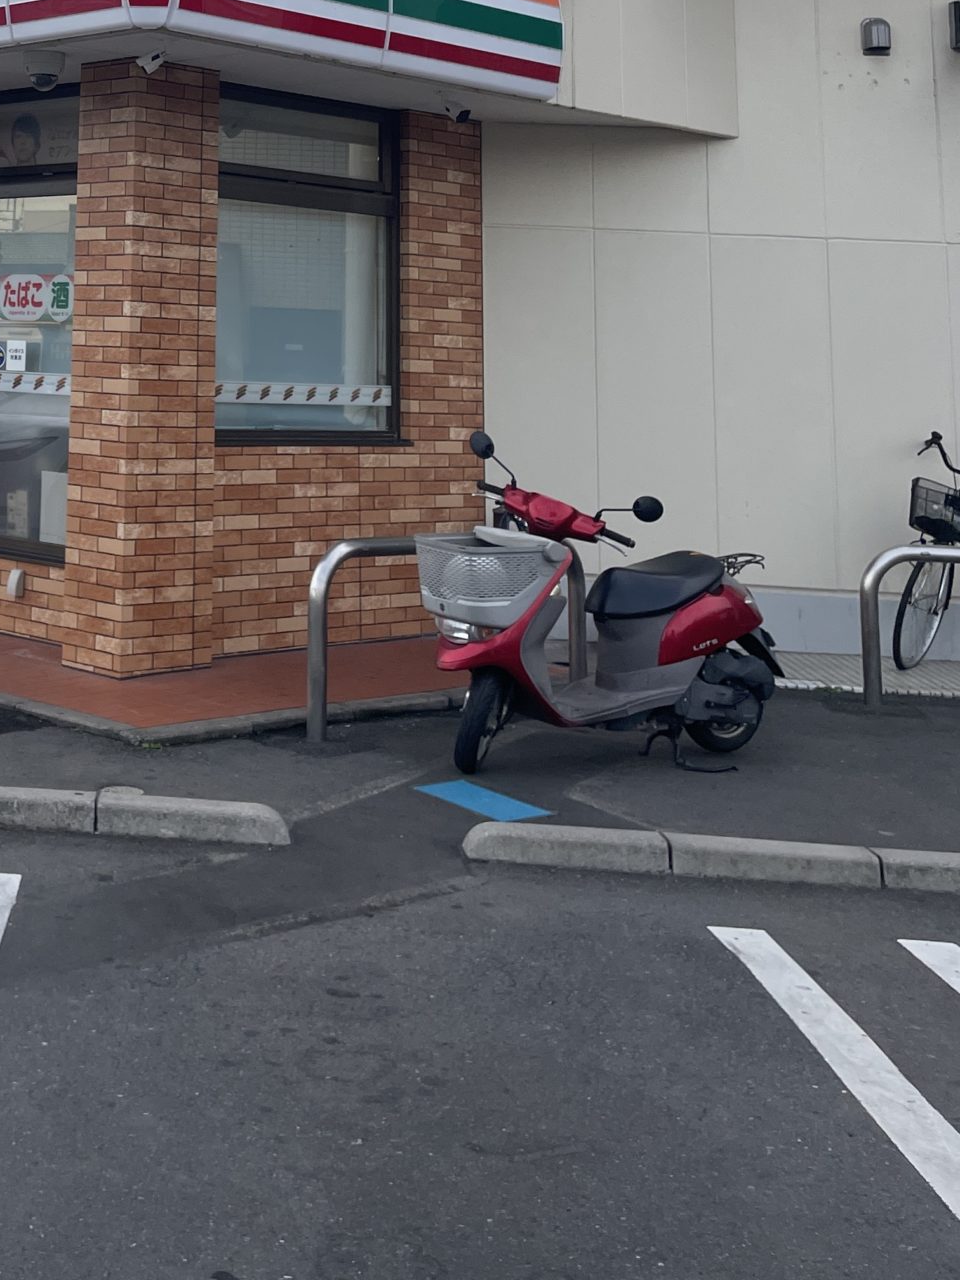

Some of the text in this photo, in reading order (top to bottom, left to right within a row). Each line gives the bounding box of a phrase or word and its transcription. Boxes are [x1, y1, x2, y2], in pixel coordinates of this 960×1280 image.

[3, 281, 44, 309] たばこ
[51, 281, 70, 309] 酒
